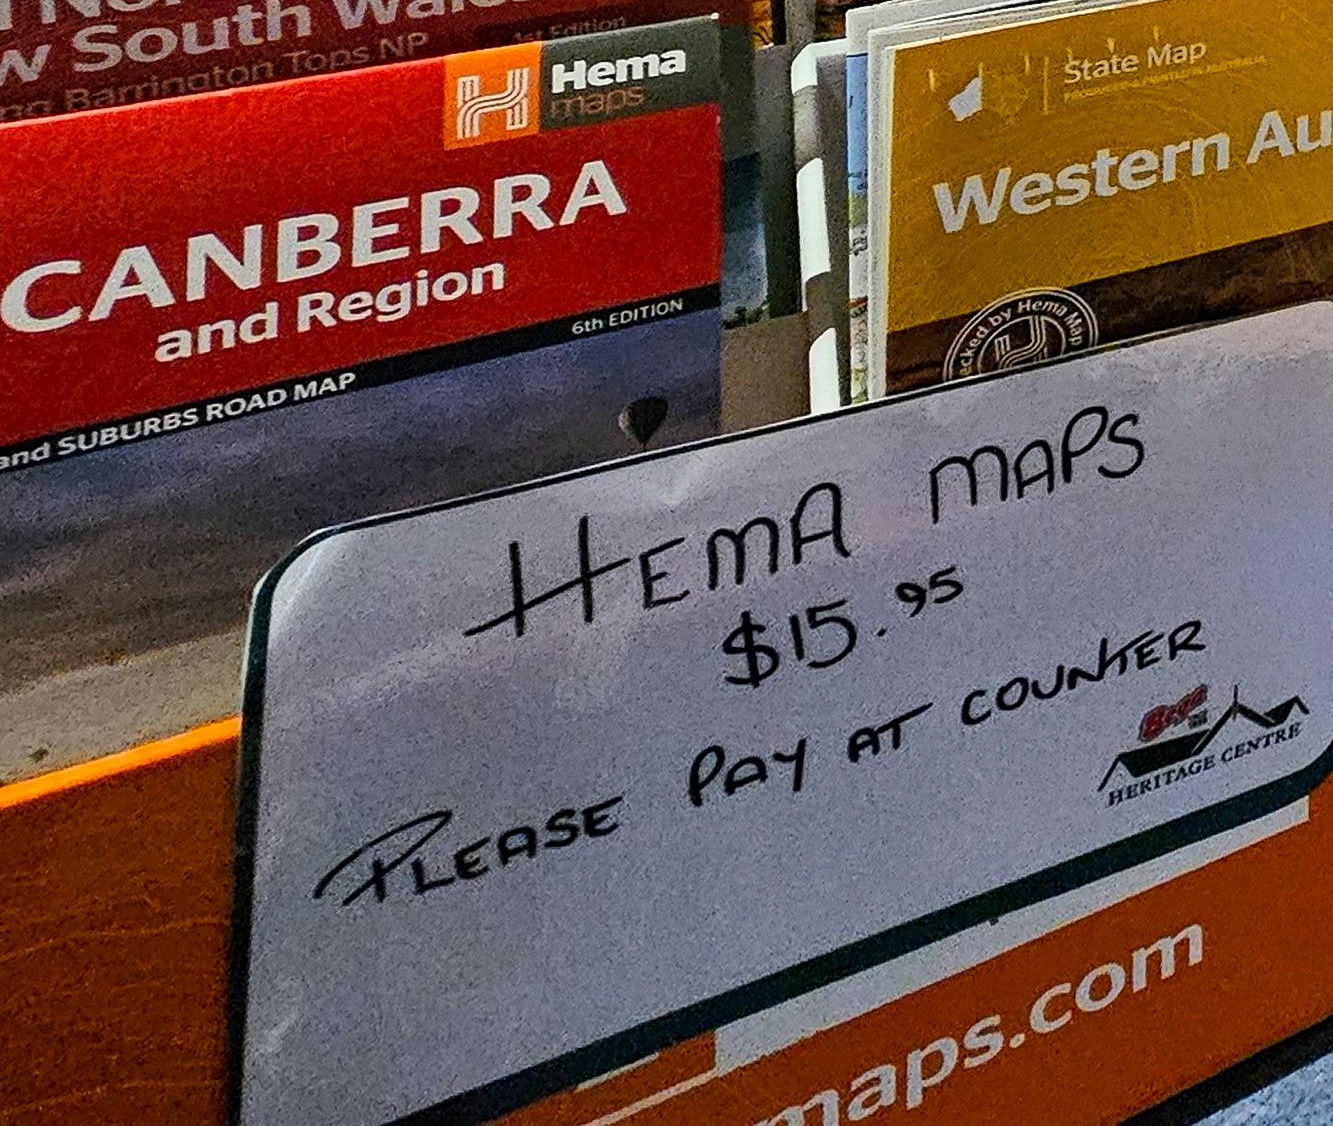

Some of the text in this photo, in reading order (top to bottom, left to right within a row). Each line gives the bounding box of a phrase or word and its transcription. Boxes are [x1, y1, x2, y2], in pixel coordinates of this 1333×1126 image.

[284, 46, 372, 80] Tops
[379, 30, 431, 60] NP
[551, 49, 687, 94] Hema
[1064, 55, 1138, 86] State
[1147, 40, 1209, 69] Map
[551, 85, 645, 119] maps
[933, 131, 1232, 235] Western
[1, 159, 628, 334] CANBERRA
[154, 262, 506, 363] and Region
[572, 296, 686, 336] 6th EDITION
[0, 372, 357, 471] and SUBURBS ROAD MAP
[464, 405, 1148, 638] HEMA MAPS
[314, 619, 1208, 909] PLEASE PAY AT COUNTER
[1107, 724, 1304, 809] HERITAGE CENTRE
